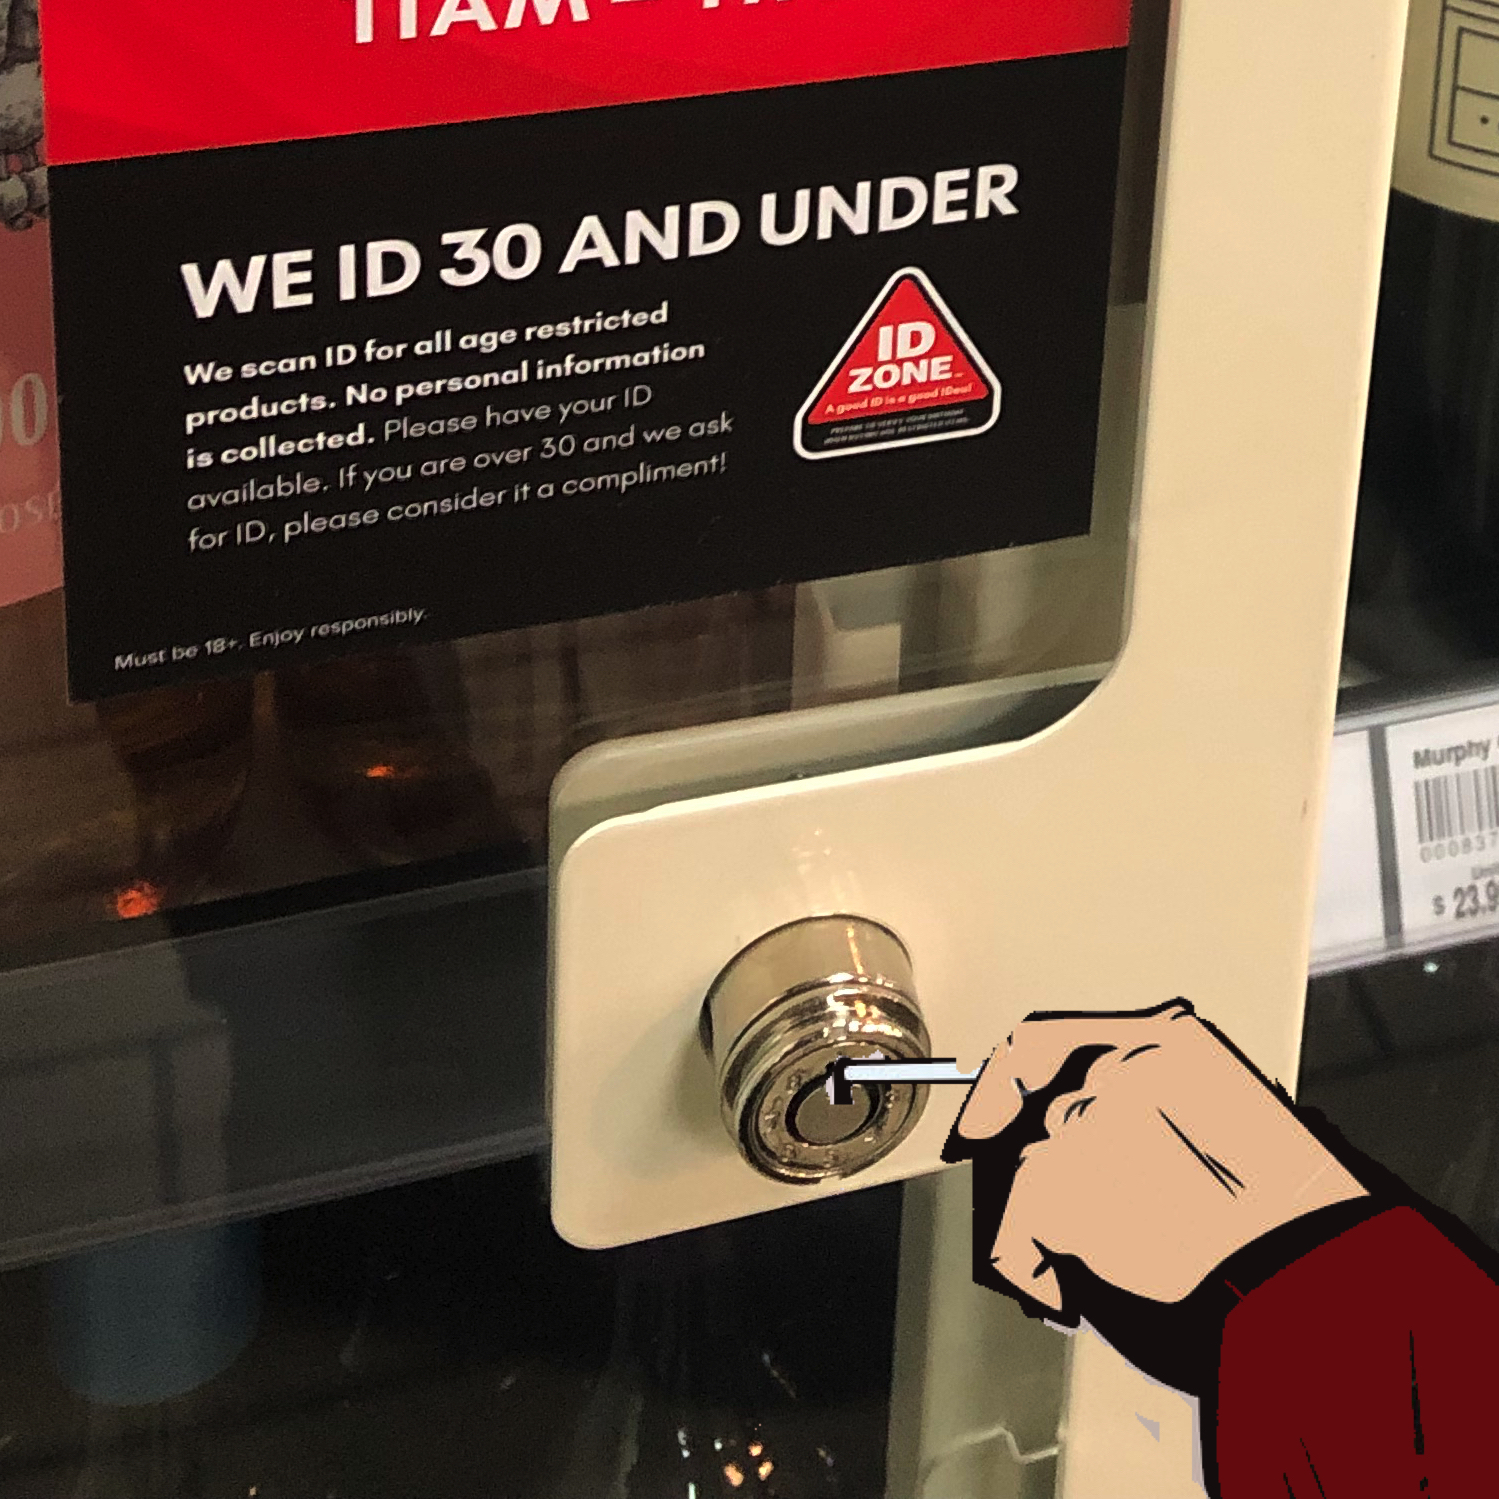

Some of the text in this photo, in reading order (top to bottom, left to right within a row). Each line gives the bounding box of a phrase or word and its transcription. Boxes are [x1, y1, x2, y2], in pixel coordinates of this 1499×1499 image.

[180, 163, 1021, 320] WE ID 30 AND UNDER
[183, 301, 669, 386] We scan ID for all age restricted
[847, 354, 954, 394] ZONE
[877, 320, 936, 362] ID
[185, 341, 706, 435] products. No personal information
[185, 384, 653, 470] is collected. Please have your ID
[186, 411, 735, 512] available. If you are over 30 and we ask
[186, 452, 729, 553] for ID, please consider it a compliment!
[114, 649, 166, 671] Must
[172, 645, 198, 660] be
[249, 628, 305, 649] Enjoy
[310, 607, 428, 638] responsibly.
[1413, 739, 1491, 769] Murphy
